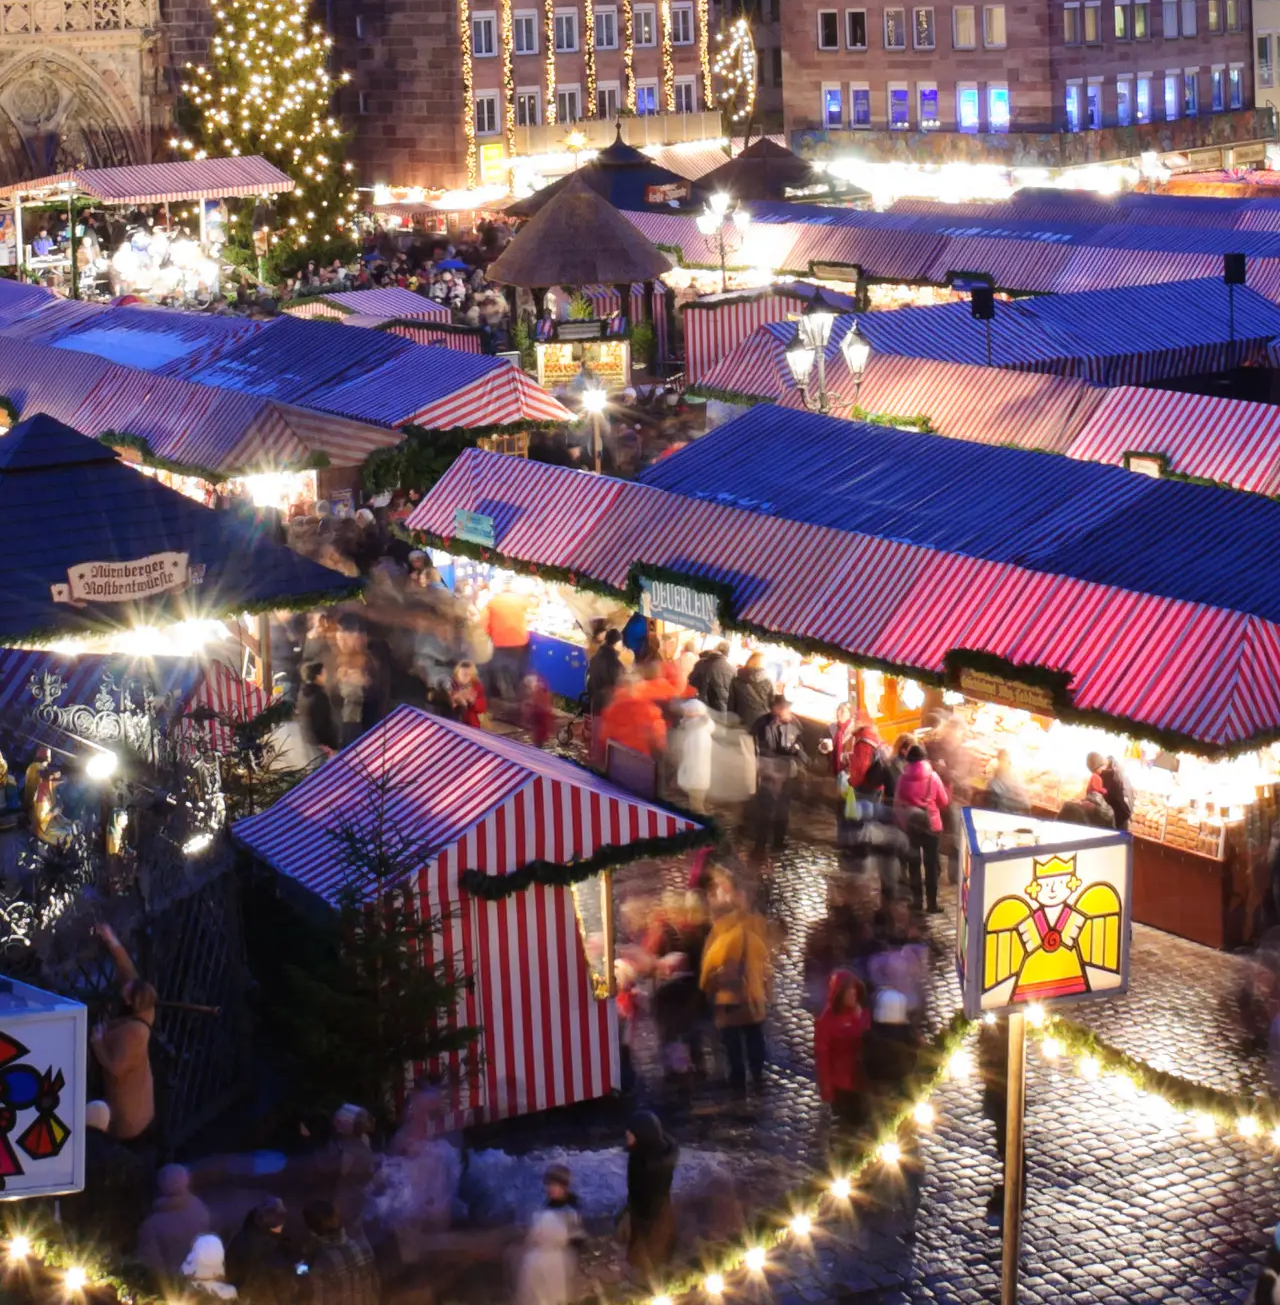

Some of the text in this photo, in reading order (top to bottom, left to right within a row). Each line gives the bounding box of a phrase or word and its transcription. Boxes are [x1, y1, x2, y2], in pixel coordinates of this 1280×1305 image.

[90, 559, 165, 579] Nürnberger
[83, 571, 174, 596] Rostbratwürste
[651, 580, 715, 621] DEUERLEIN
